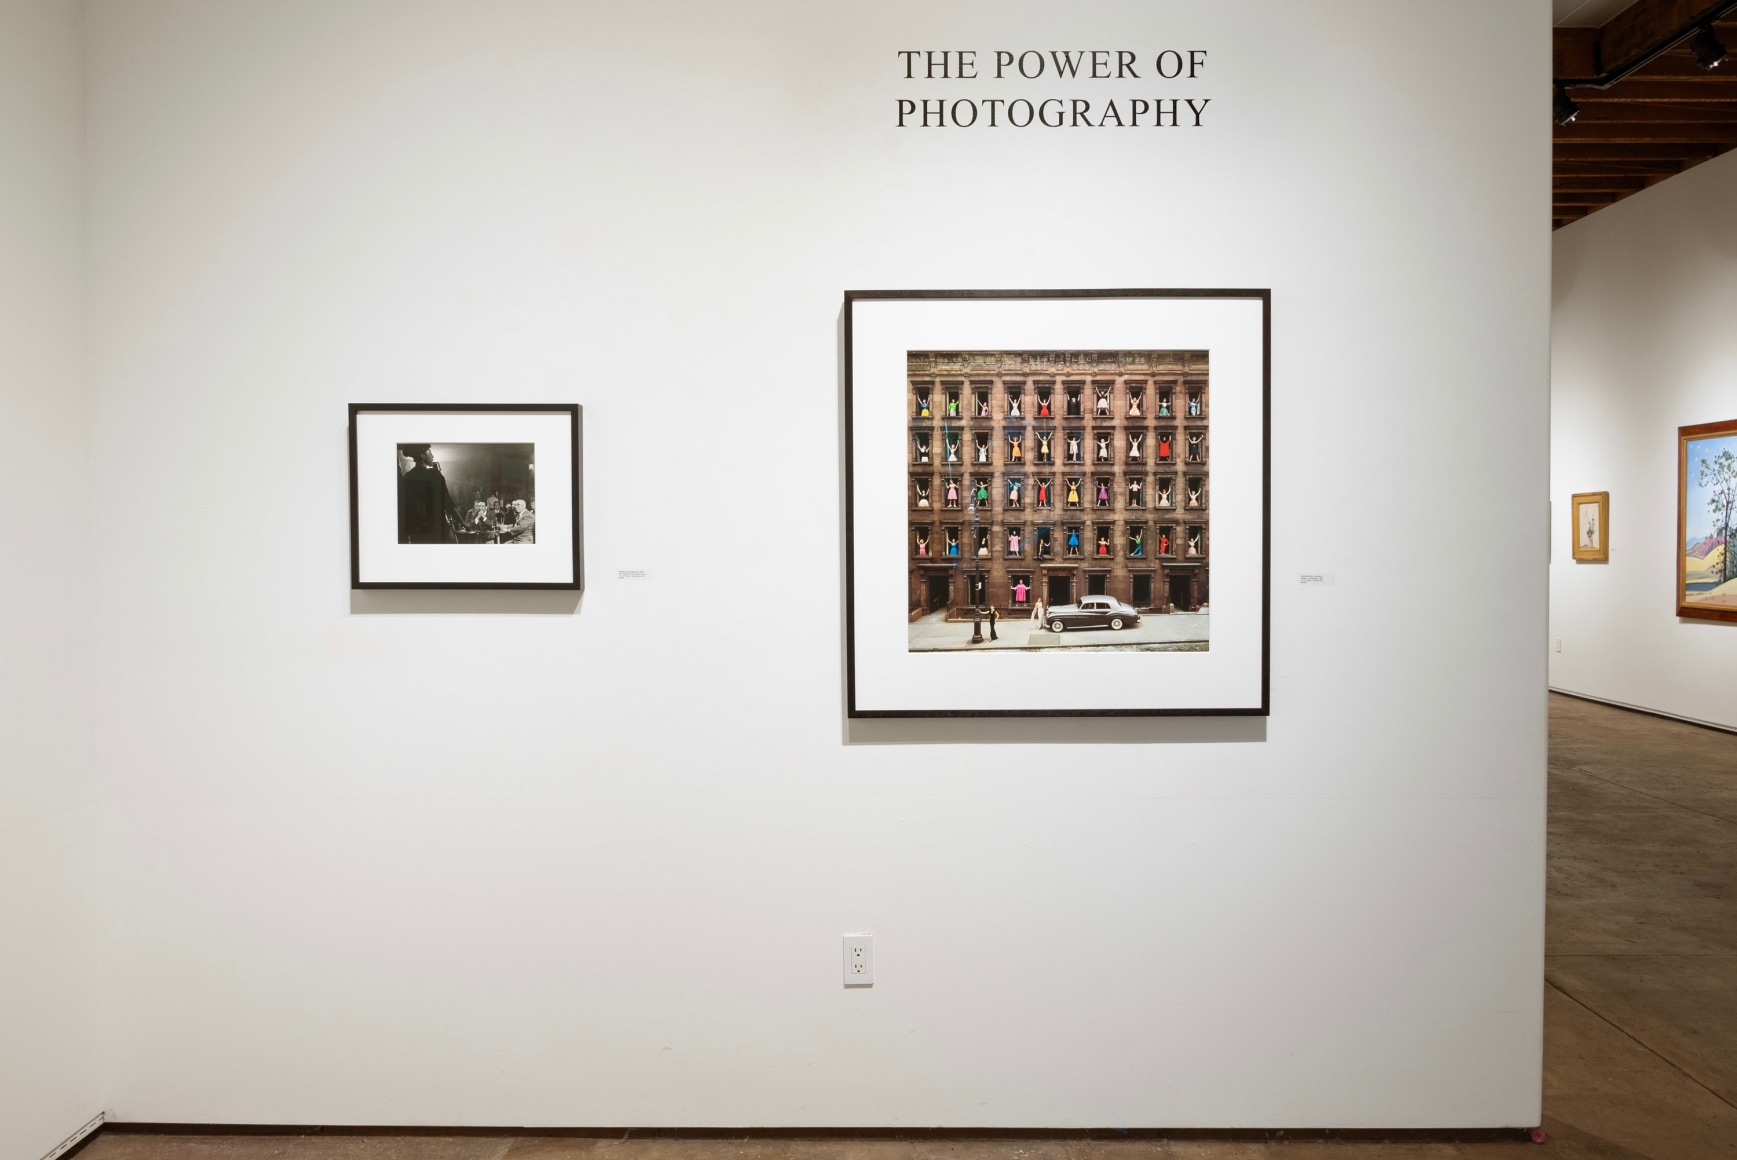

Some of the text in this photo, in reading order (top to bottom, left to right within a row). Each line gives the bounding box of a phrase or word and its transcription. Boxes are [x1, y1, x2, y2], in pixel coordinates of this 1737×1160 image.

[897, 50, 1208, 79] THE POWER OF
[895, 99, 1212, 128] PHOTOGRAPHY
